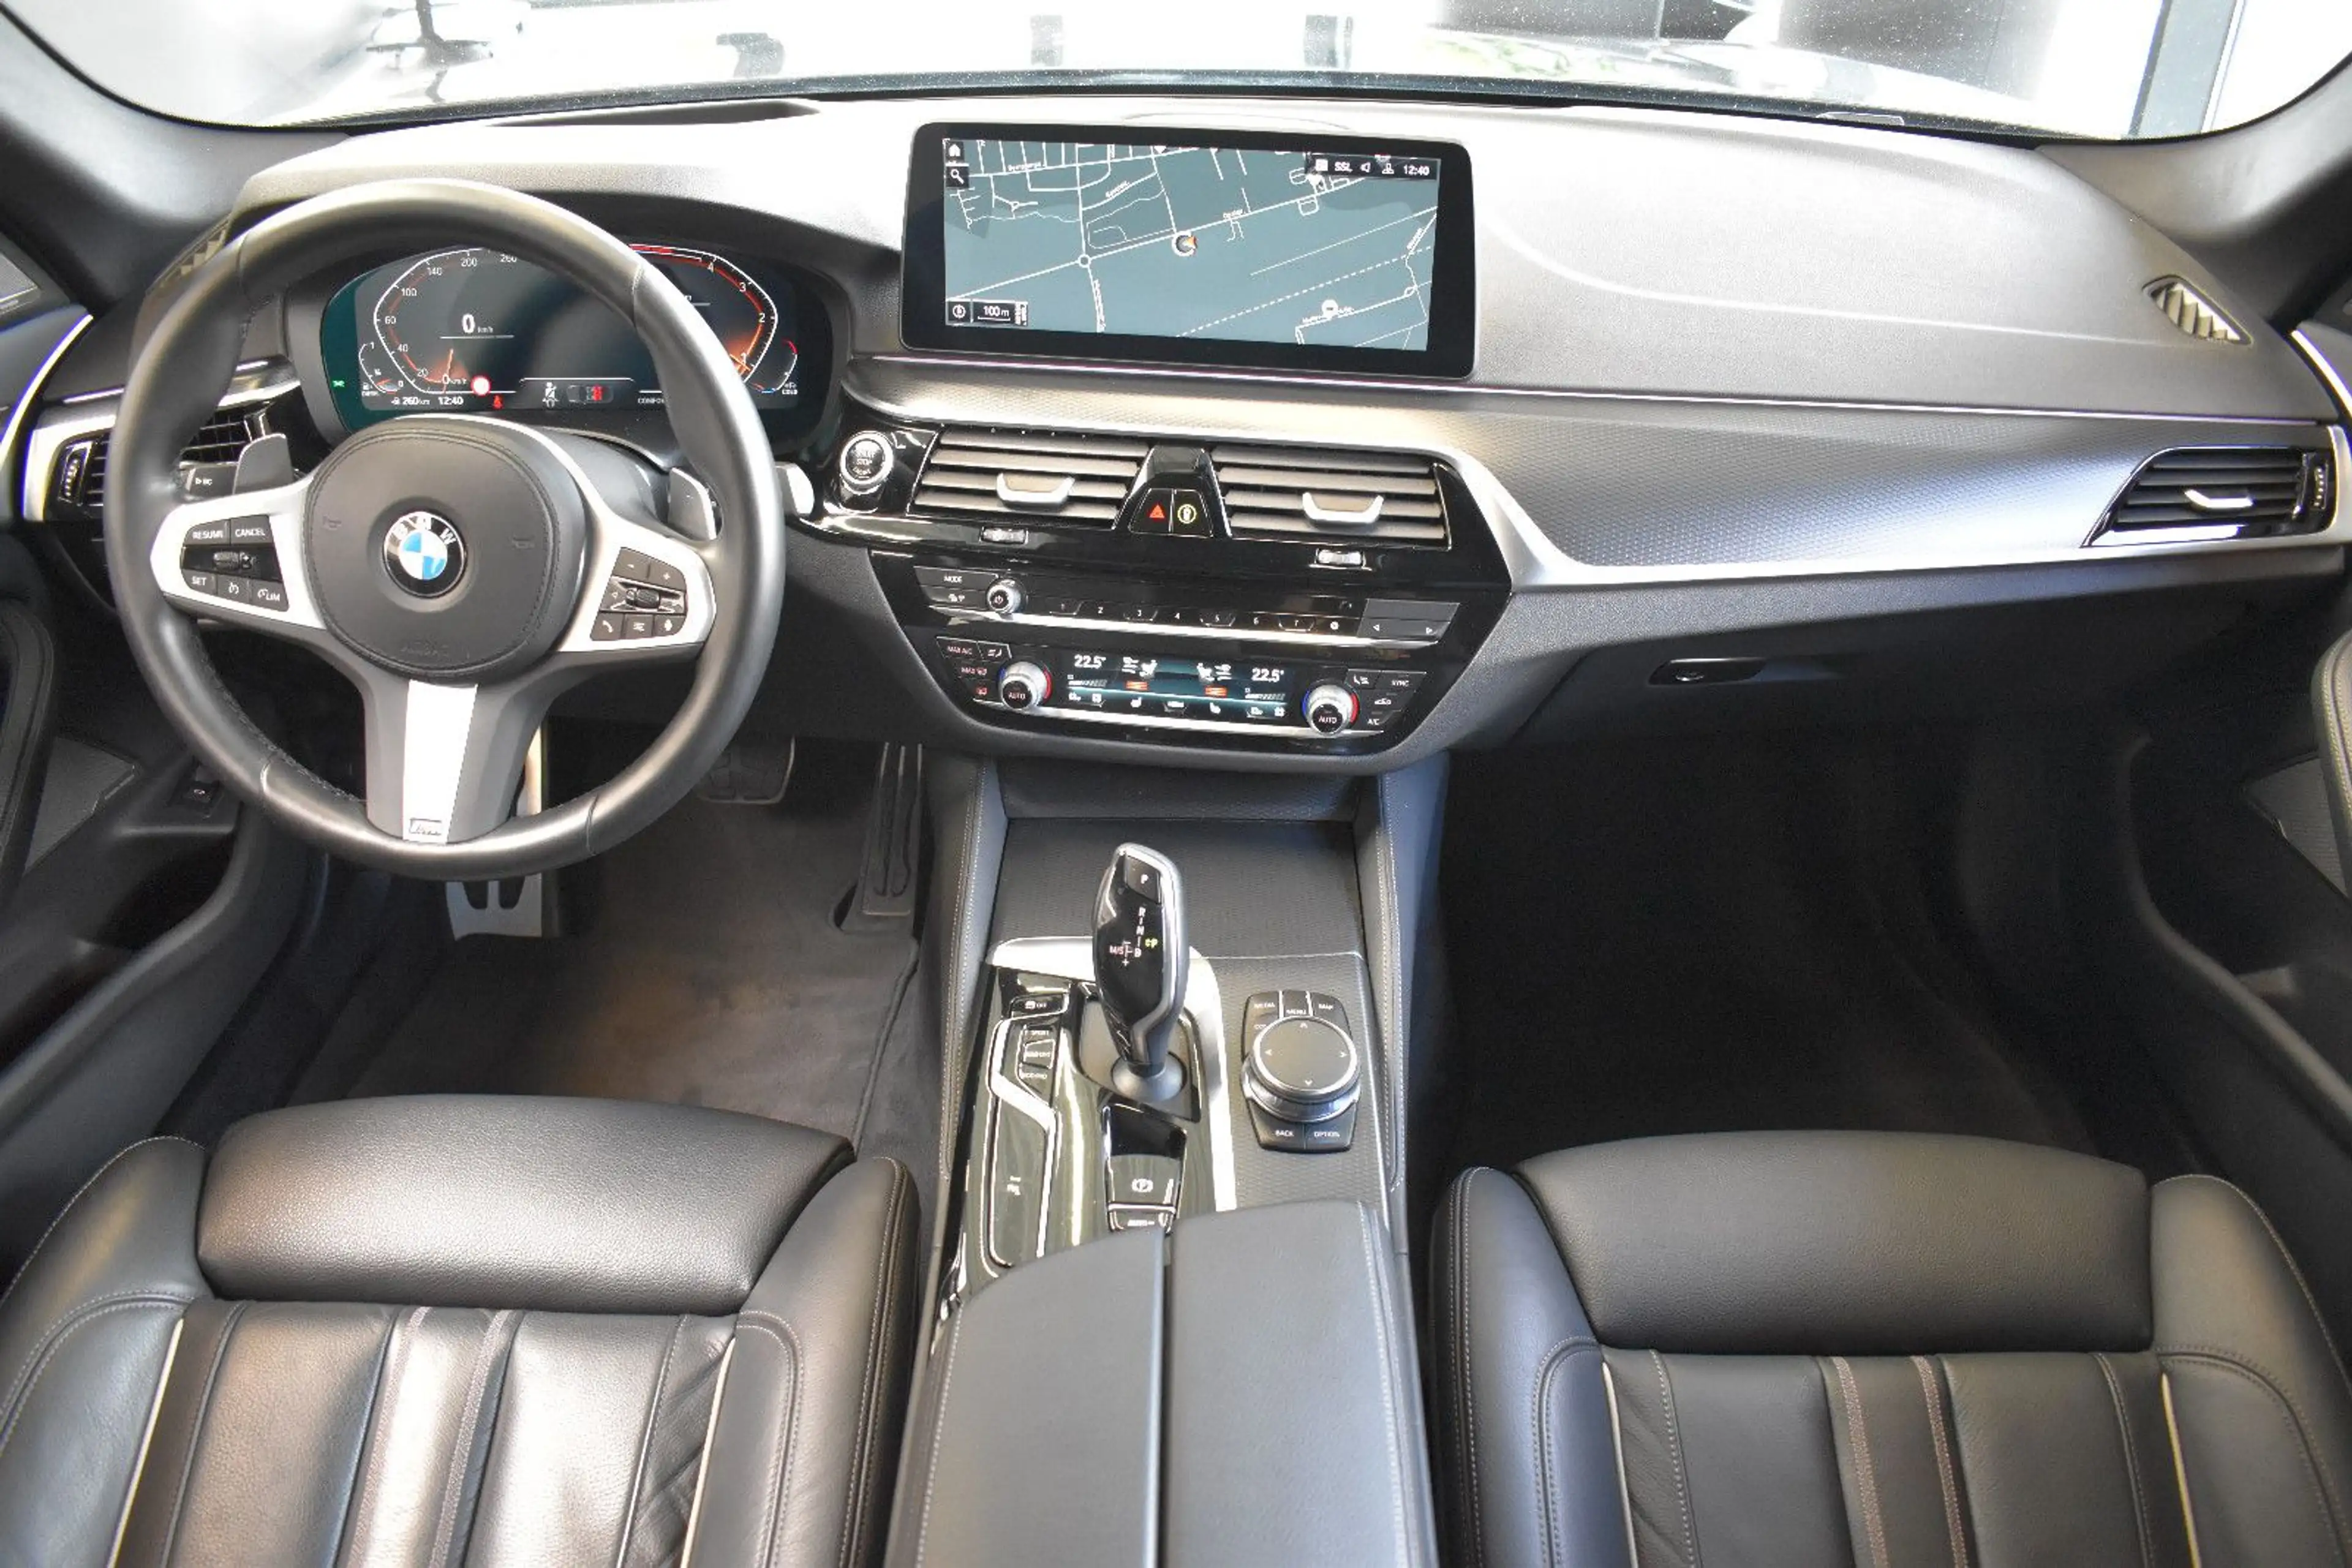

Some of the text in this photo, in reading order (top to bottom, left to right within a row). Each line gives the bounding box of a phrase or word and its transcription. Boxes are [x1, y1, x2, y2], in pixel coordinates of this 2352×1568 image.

[1403, 165, 1430, 175] 12:40
[460, 258, 477, 267] 200
[707, 262, 714, 272] 4
[739, 282, 746, 292] 3
[401, 288, 417, 297] 100
[983, 306, 1000, 317] 100
[385, 316, 397, 325] 60
[759, 313, 765, 322] 2
[462, 313, 476, 334] 0
[398, 344, 409, 352] 40
[402, 397, 418, 405] 260
[438, 397, 464, 405] 12:40
[235, 528, 265, 537] CANCEL
[192, 576, 206, 586] SET
[1140, 874, 1148, 884] P
[1139, 907, 1146, 917] R
